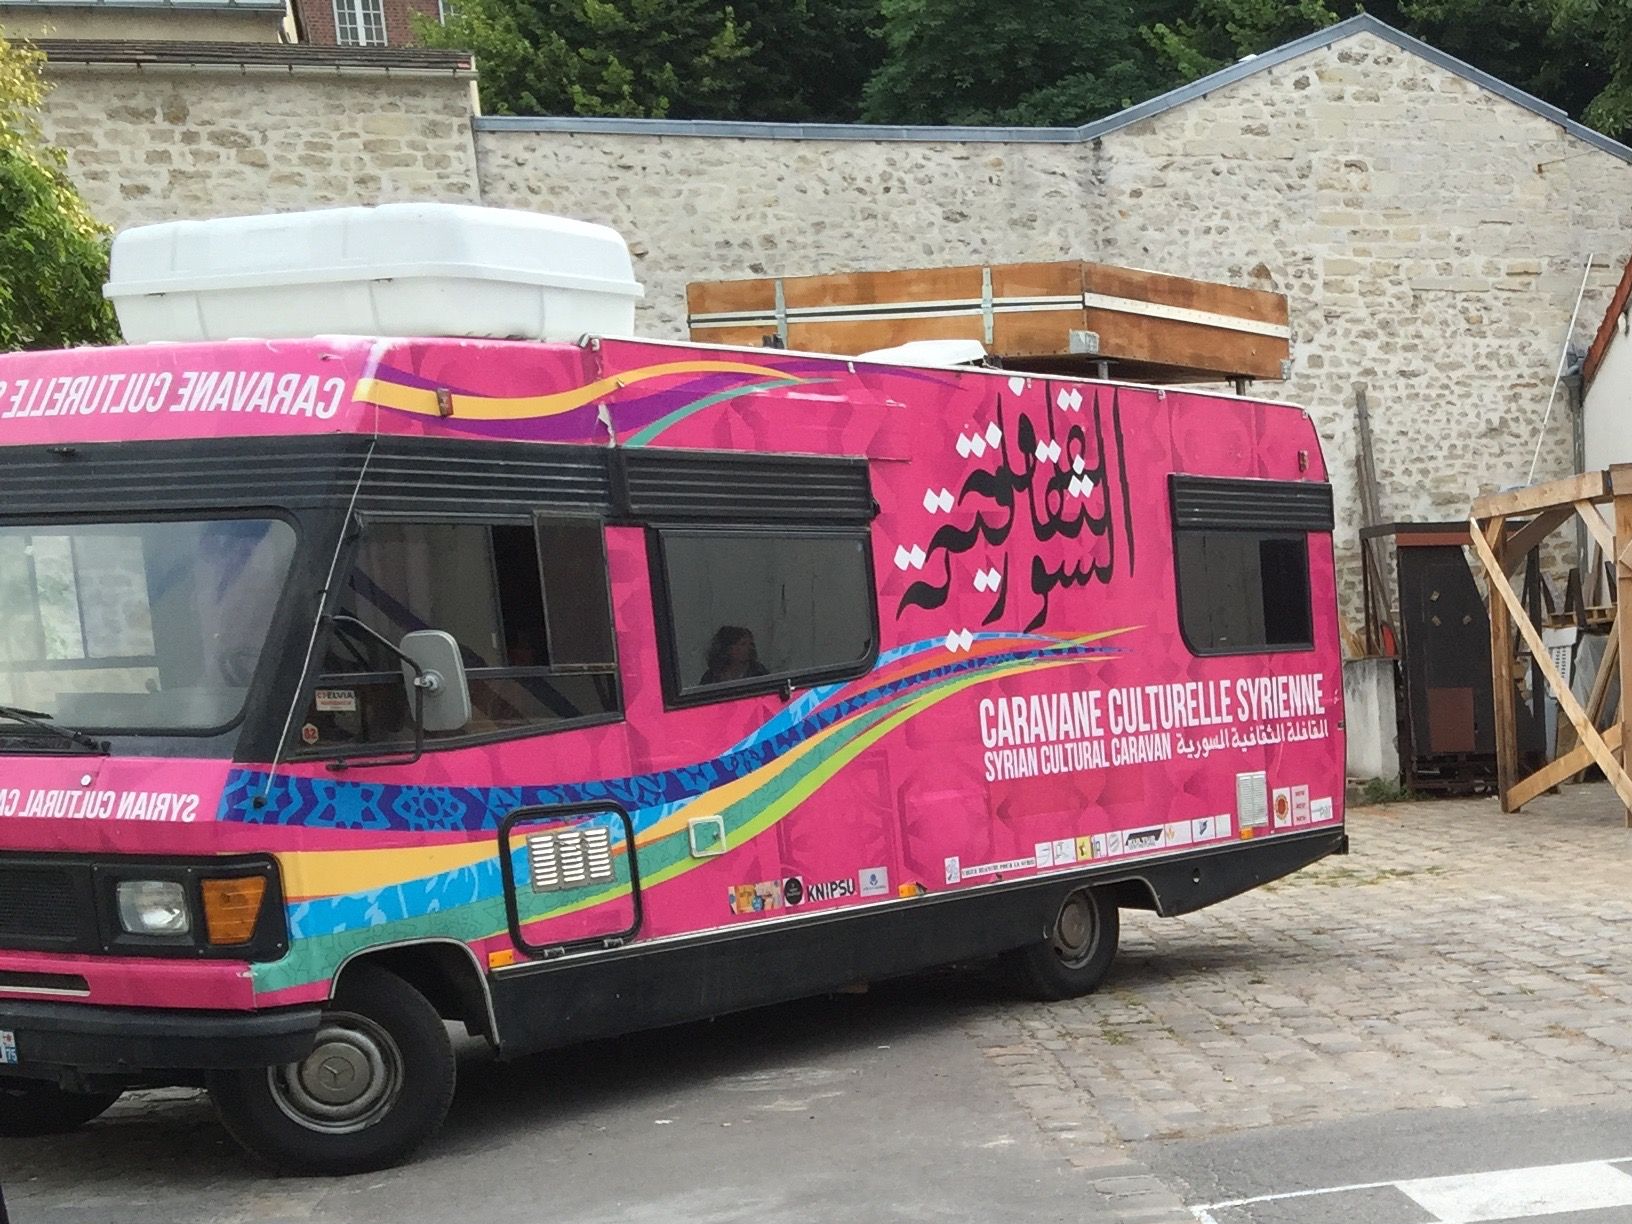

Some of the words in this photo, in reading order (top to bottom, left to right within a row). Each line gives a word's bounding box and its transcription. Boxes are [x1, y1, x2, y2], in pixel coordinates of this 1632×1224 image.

[979, 690, 1104, 749] CARAVANE
[1107, 682, 1233, 736] CULTURELLE
[1236, 673, 1325, 724] SYRIENNE
[1176, 729, 1230, 759] السورية
[1231, 723, 1285, 753] الثقافية
[1286, 719, 1329, 743] القافلة
[984, 747, 1039, 783] SYRIAN
[1041, 740, 1110, 775] CULTURAL
[1112, 733, 1172, 767] CARAVAN
[807, 878, 856, 903] KNIPSU
[6, 1048, 17, 1062] 75
